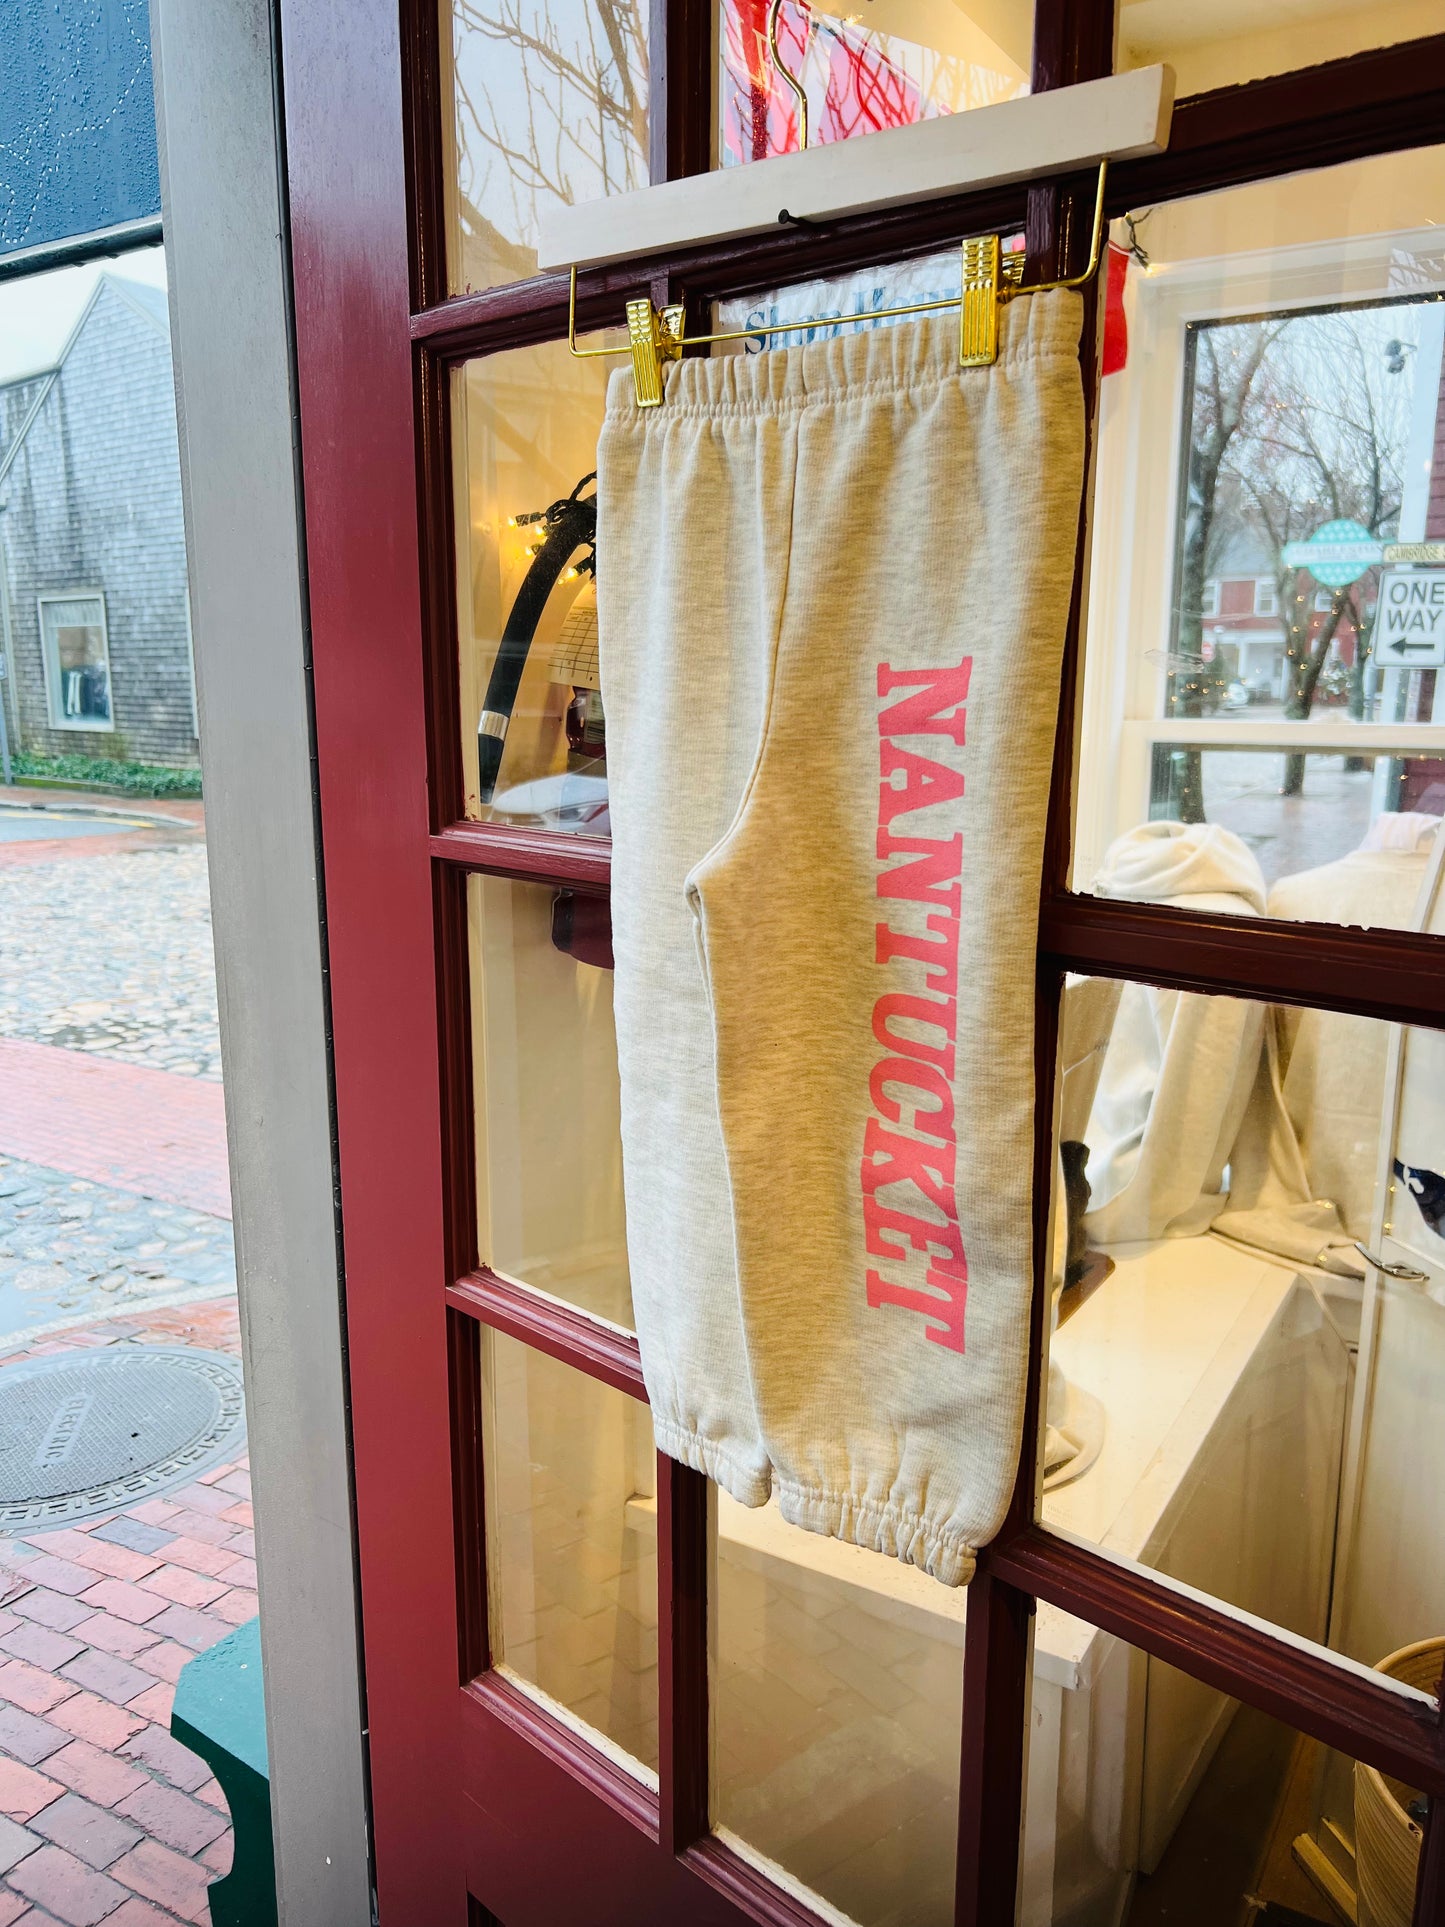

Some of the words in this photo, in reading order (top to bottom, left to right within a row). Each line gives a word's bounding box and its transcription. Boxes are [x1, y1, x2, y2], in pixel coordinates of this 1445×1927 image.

[1390, 582, 1445, 605] ONE
[1387, 609, 1442, 632] WAY
[860, 656, 972, 1353] NANTUCKET
